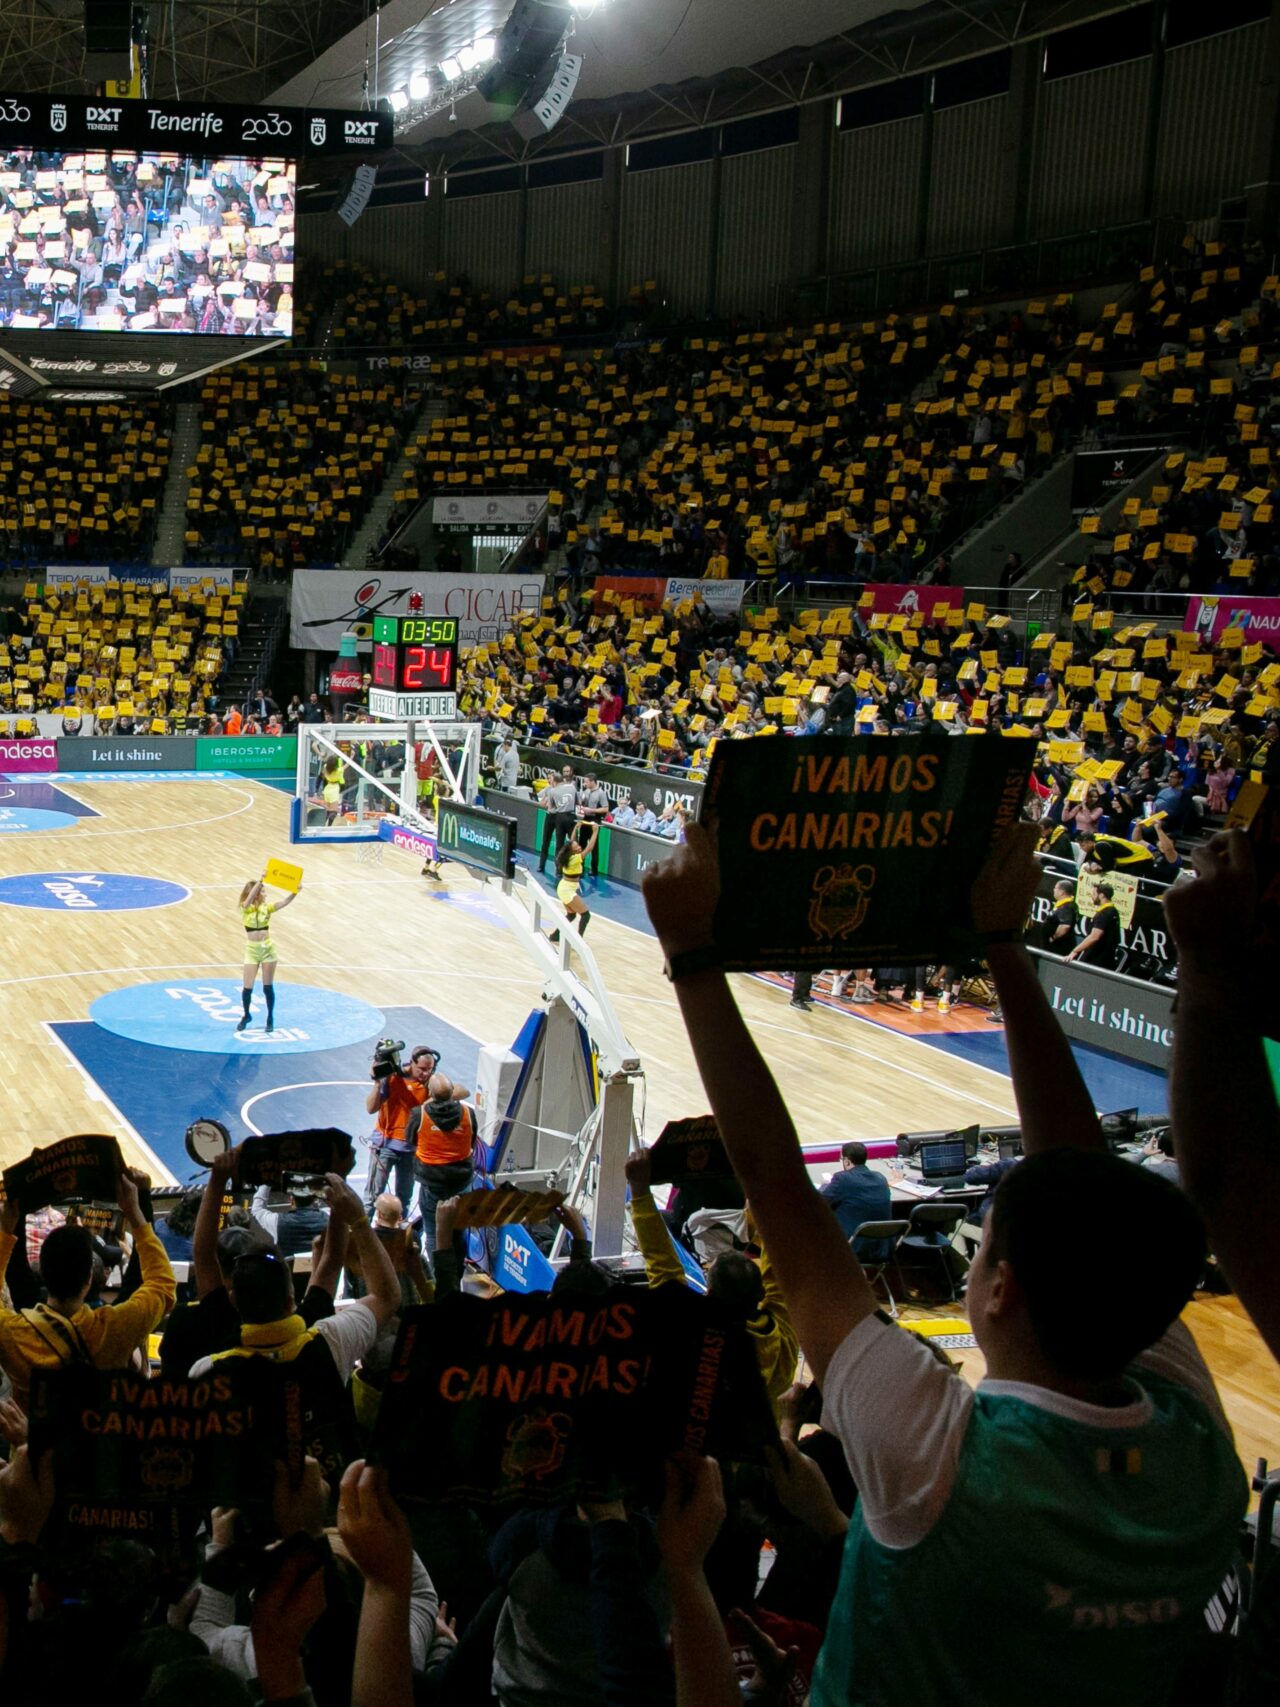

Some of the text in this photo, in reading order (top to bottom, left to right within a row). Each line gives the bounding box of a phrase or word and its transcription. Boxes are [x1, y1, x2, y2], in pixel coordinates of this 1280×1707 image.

[86, 106, 122, 123] DXT
[86, 123, 120, 132] TENERIFE
[147, 109, 292, 141] Tenerife 2030
[344, 120, 380, 136] DXT
[344, 136, 376, 145] TENERIFE
[29, 356, 97, 373] Tenerife
[402, 620, 456, 641] 03:50
[373, 646, 396, 685] 24
[402, 648, 451, 688] 24
[398, 697, 455, 716] ATEFUER
[92, 748, 163, 762] Let it shine
[210, 746, 275, 756] IBEROSTAR
[791, 752, 941, 795] ¡VAMOS
[459, 826, 501, 851] McDonald's
[748, 808, 955, 852] CANARIAS!
[393, 832, 433, 859] endesa
[1051, 986, 1174, 1047] Let it shine
[504, 1234, 531, 1267] DXT
[484, 1301, 638, 1353] ¡VAMOS
[438, 1351, 655, 1404] CANARIAS!
[109, 1374, 235, 1410] ¡VAMOS
[79, 1400, 256, 1441] CANARIAS!
[67, 1503, 155, 1531] CANARIAS!
